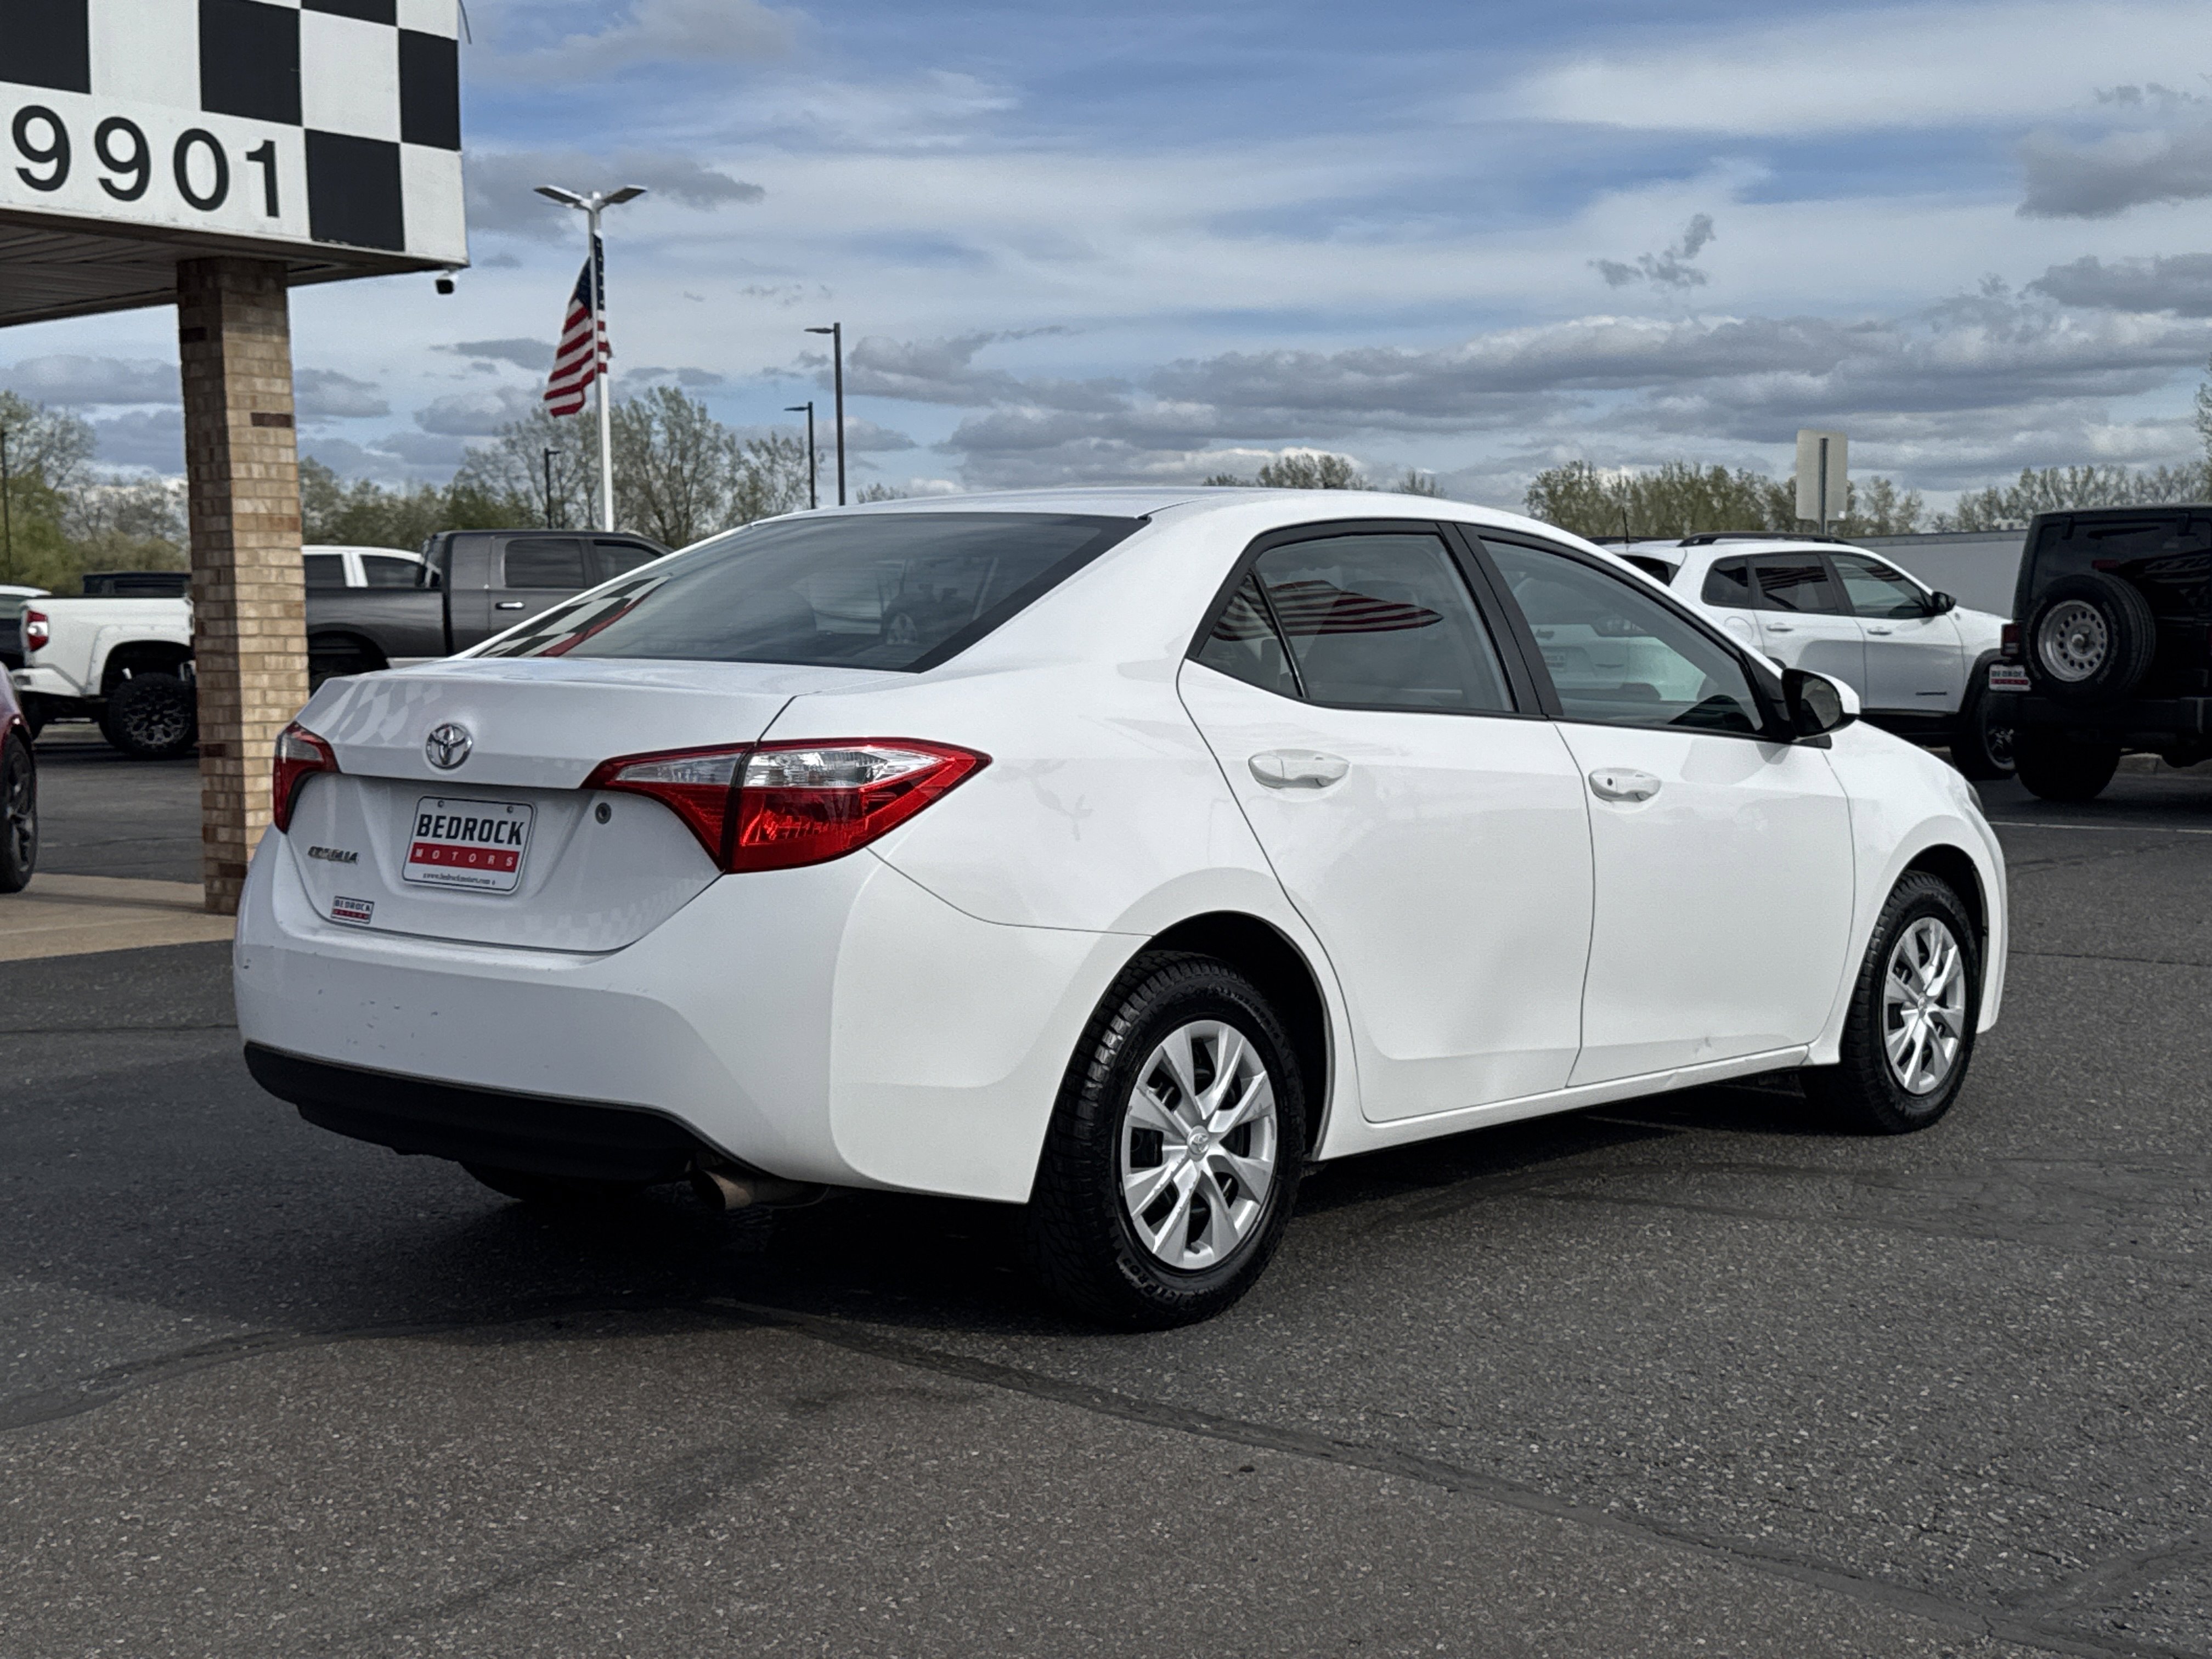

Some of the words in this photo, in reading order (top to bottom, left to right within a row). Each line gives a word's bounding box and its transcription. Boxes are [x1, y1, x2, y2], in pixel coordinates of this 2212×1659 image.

[12, 104, 279, 218] 9901
[416, 814, 524, 845] BEDROCK
[415, 848, 514, 867] MOTORS
